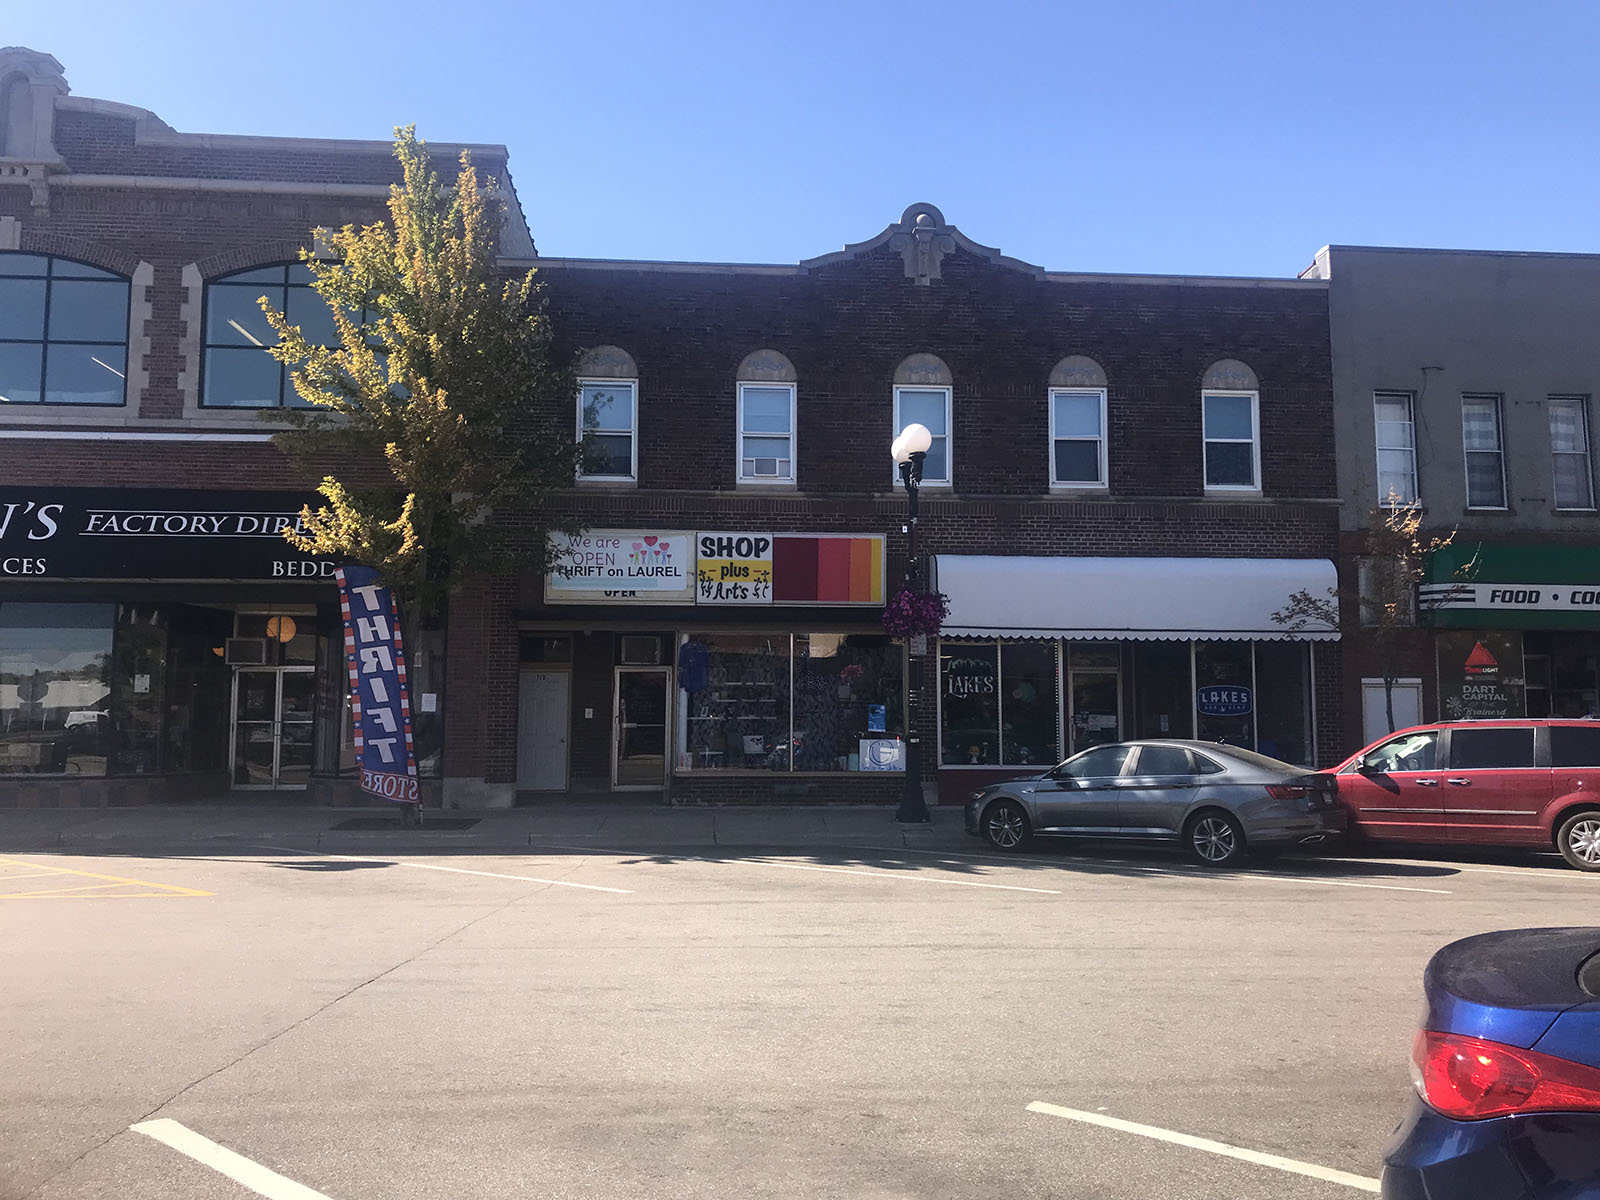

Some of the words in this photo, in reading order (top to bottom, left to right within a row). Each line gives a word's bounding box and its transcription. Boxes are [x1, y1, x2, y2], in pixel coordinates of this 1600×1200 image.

[86, 514, 229, 533] FACTORY
[234, 515, 307, 534] DIRE
[568, 535, 591, 548] We
[595, 538, 621, 549] are
[700, 536, 770, 559] SHOP
[0, 557, 47, 575] CES
[572, 552, 616, 566] OPEN
[272, 560, 337, 577] BEDD
[607, 568, 624, 577] on
[628, 566, 682, 577] LAUREL
[720, 562, 750, 580] plus
[713, 582, 749, 600] Art's
[1490, 590, 1541, 604] FOOD
[944, 674, 994, 699] LAKES
[1462, 685, 1497, 693] DART
[1201, 691, 1248, 703] LAKES
[1462, 693, 1508, 701] CAPITAL
